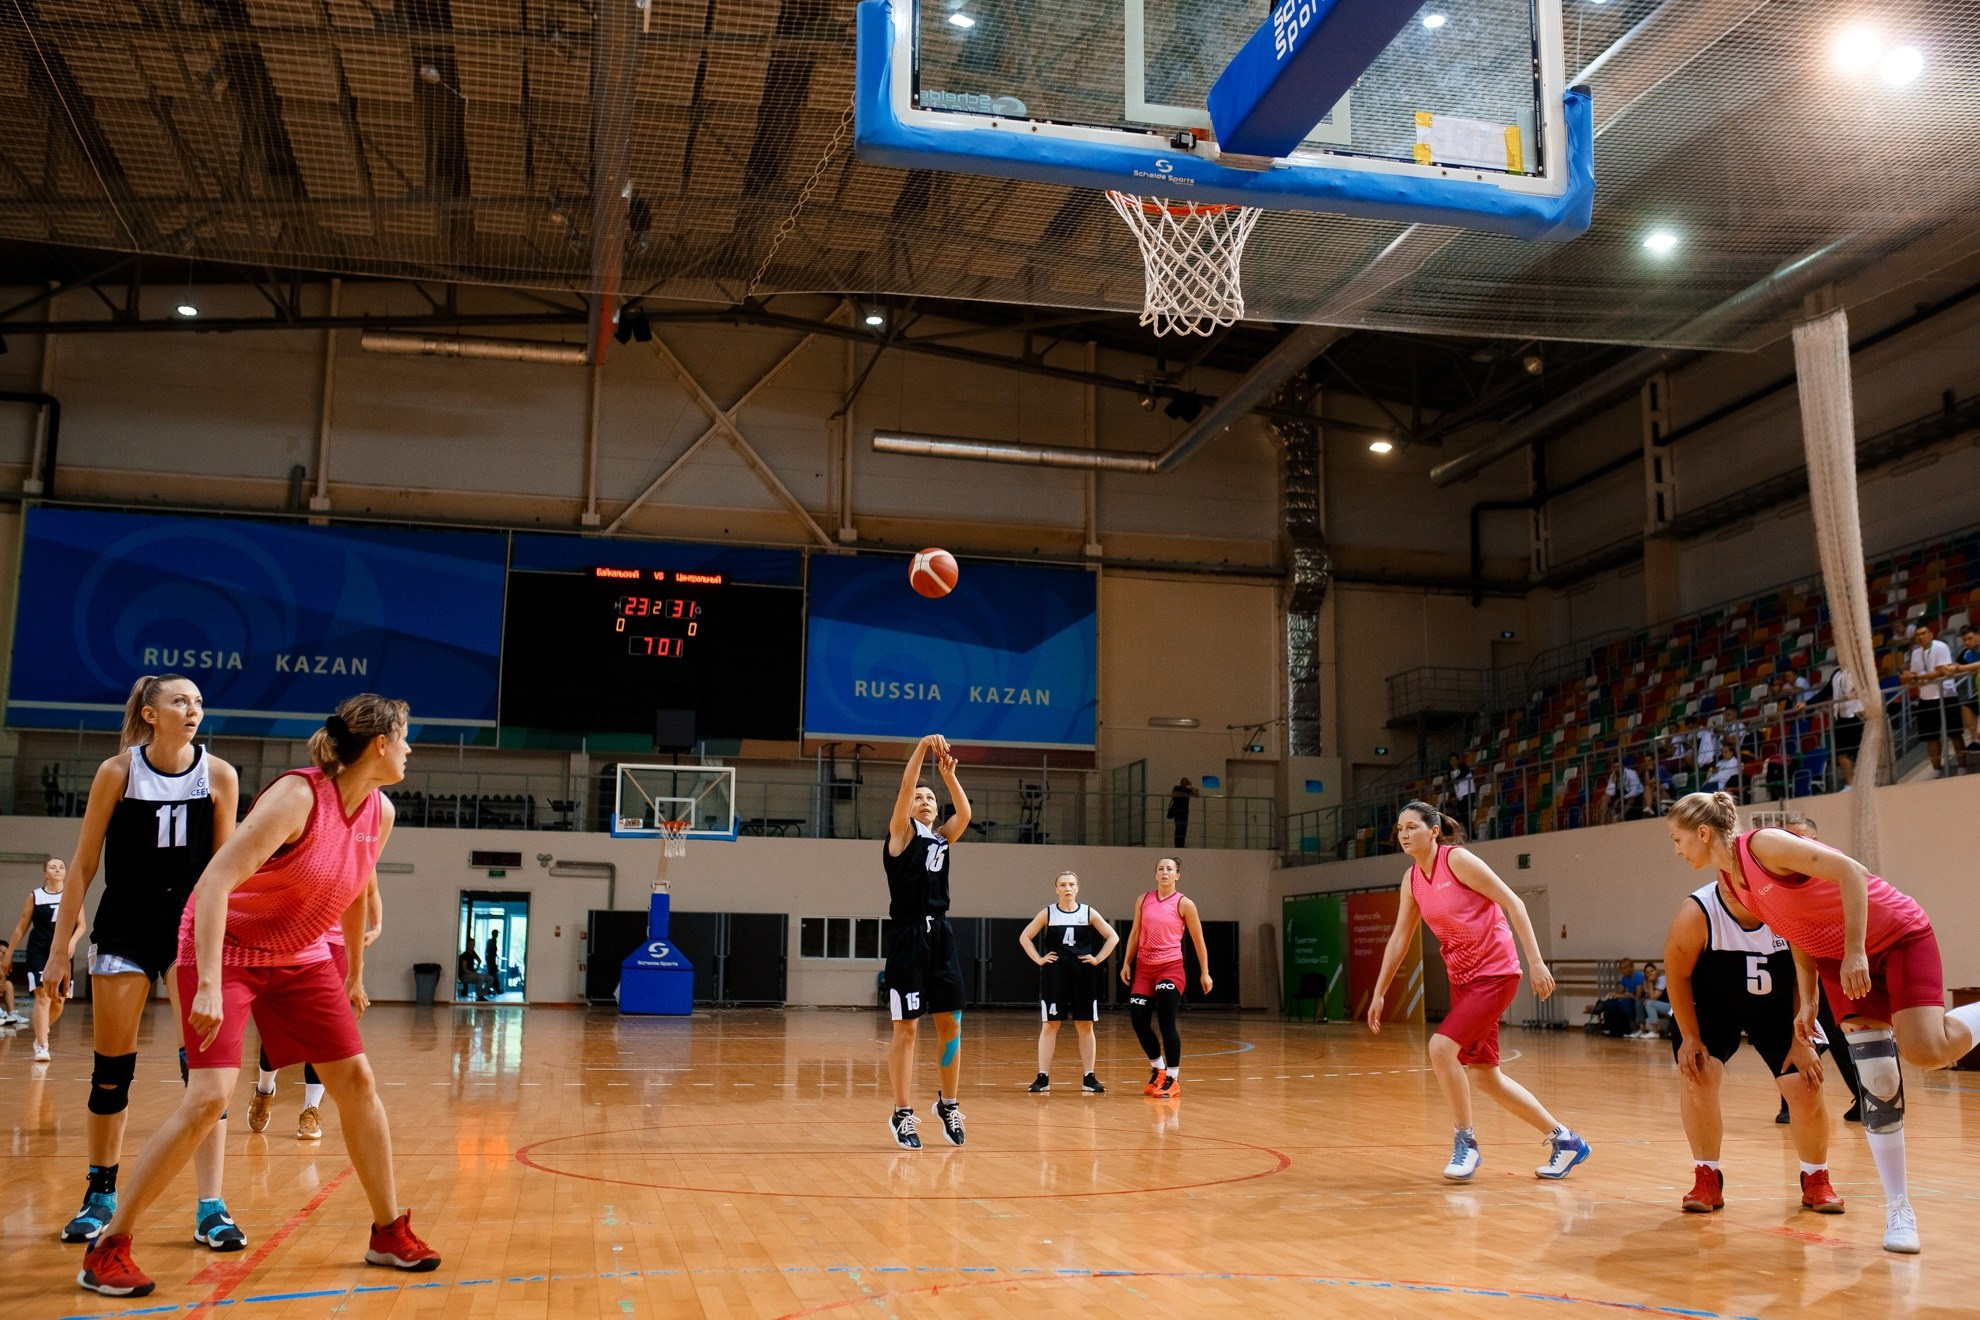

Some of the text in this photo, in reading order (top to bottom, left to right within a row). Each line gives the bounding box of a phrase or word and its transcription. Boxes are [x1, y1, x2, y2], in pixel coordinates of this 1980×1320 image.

[625, 597, 649, 616] 23
[653, 601, 662, 614] 2
[672, 600, 695, 618] 31
[616, 618, 697, 636] 0 0
[144, 648, 368, 676] RUSSIA KAZAN
[855, 680, 1050, 706] RUSSIA KAZAN
[156, 804, 188, 848] 11
[1062, 927, 1076, 947] 4
[1746, 956, 1773, 995] 5
[1155, 983, 1175, 991] PRO
[905, 991, 920, 1011] 15
[1049, 1003, 1058, 1016] 4
